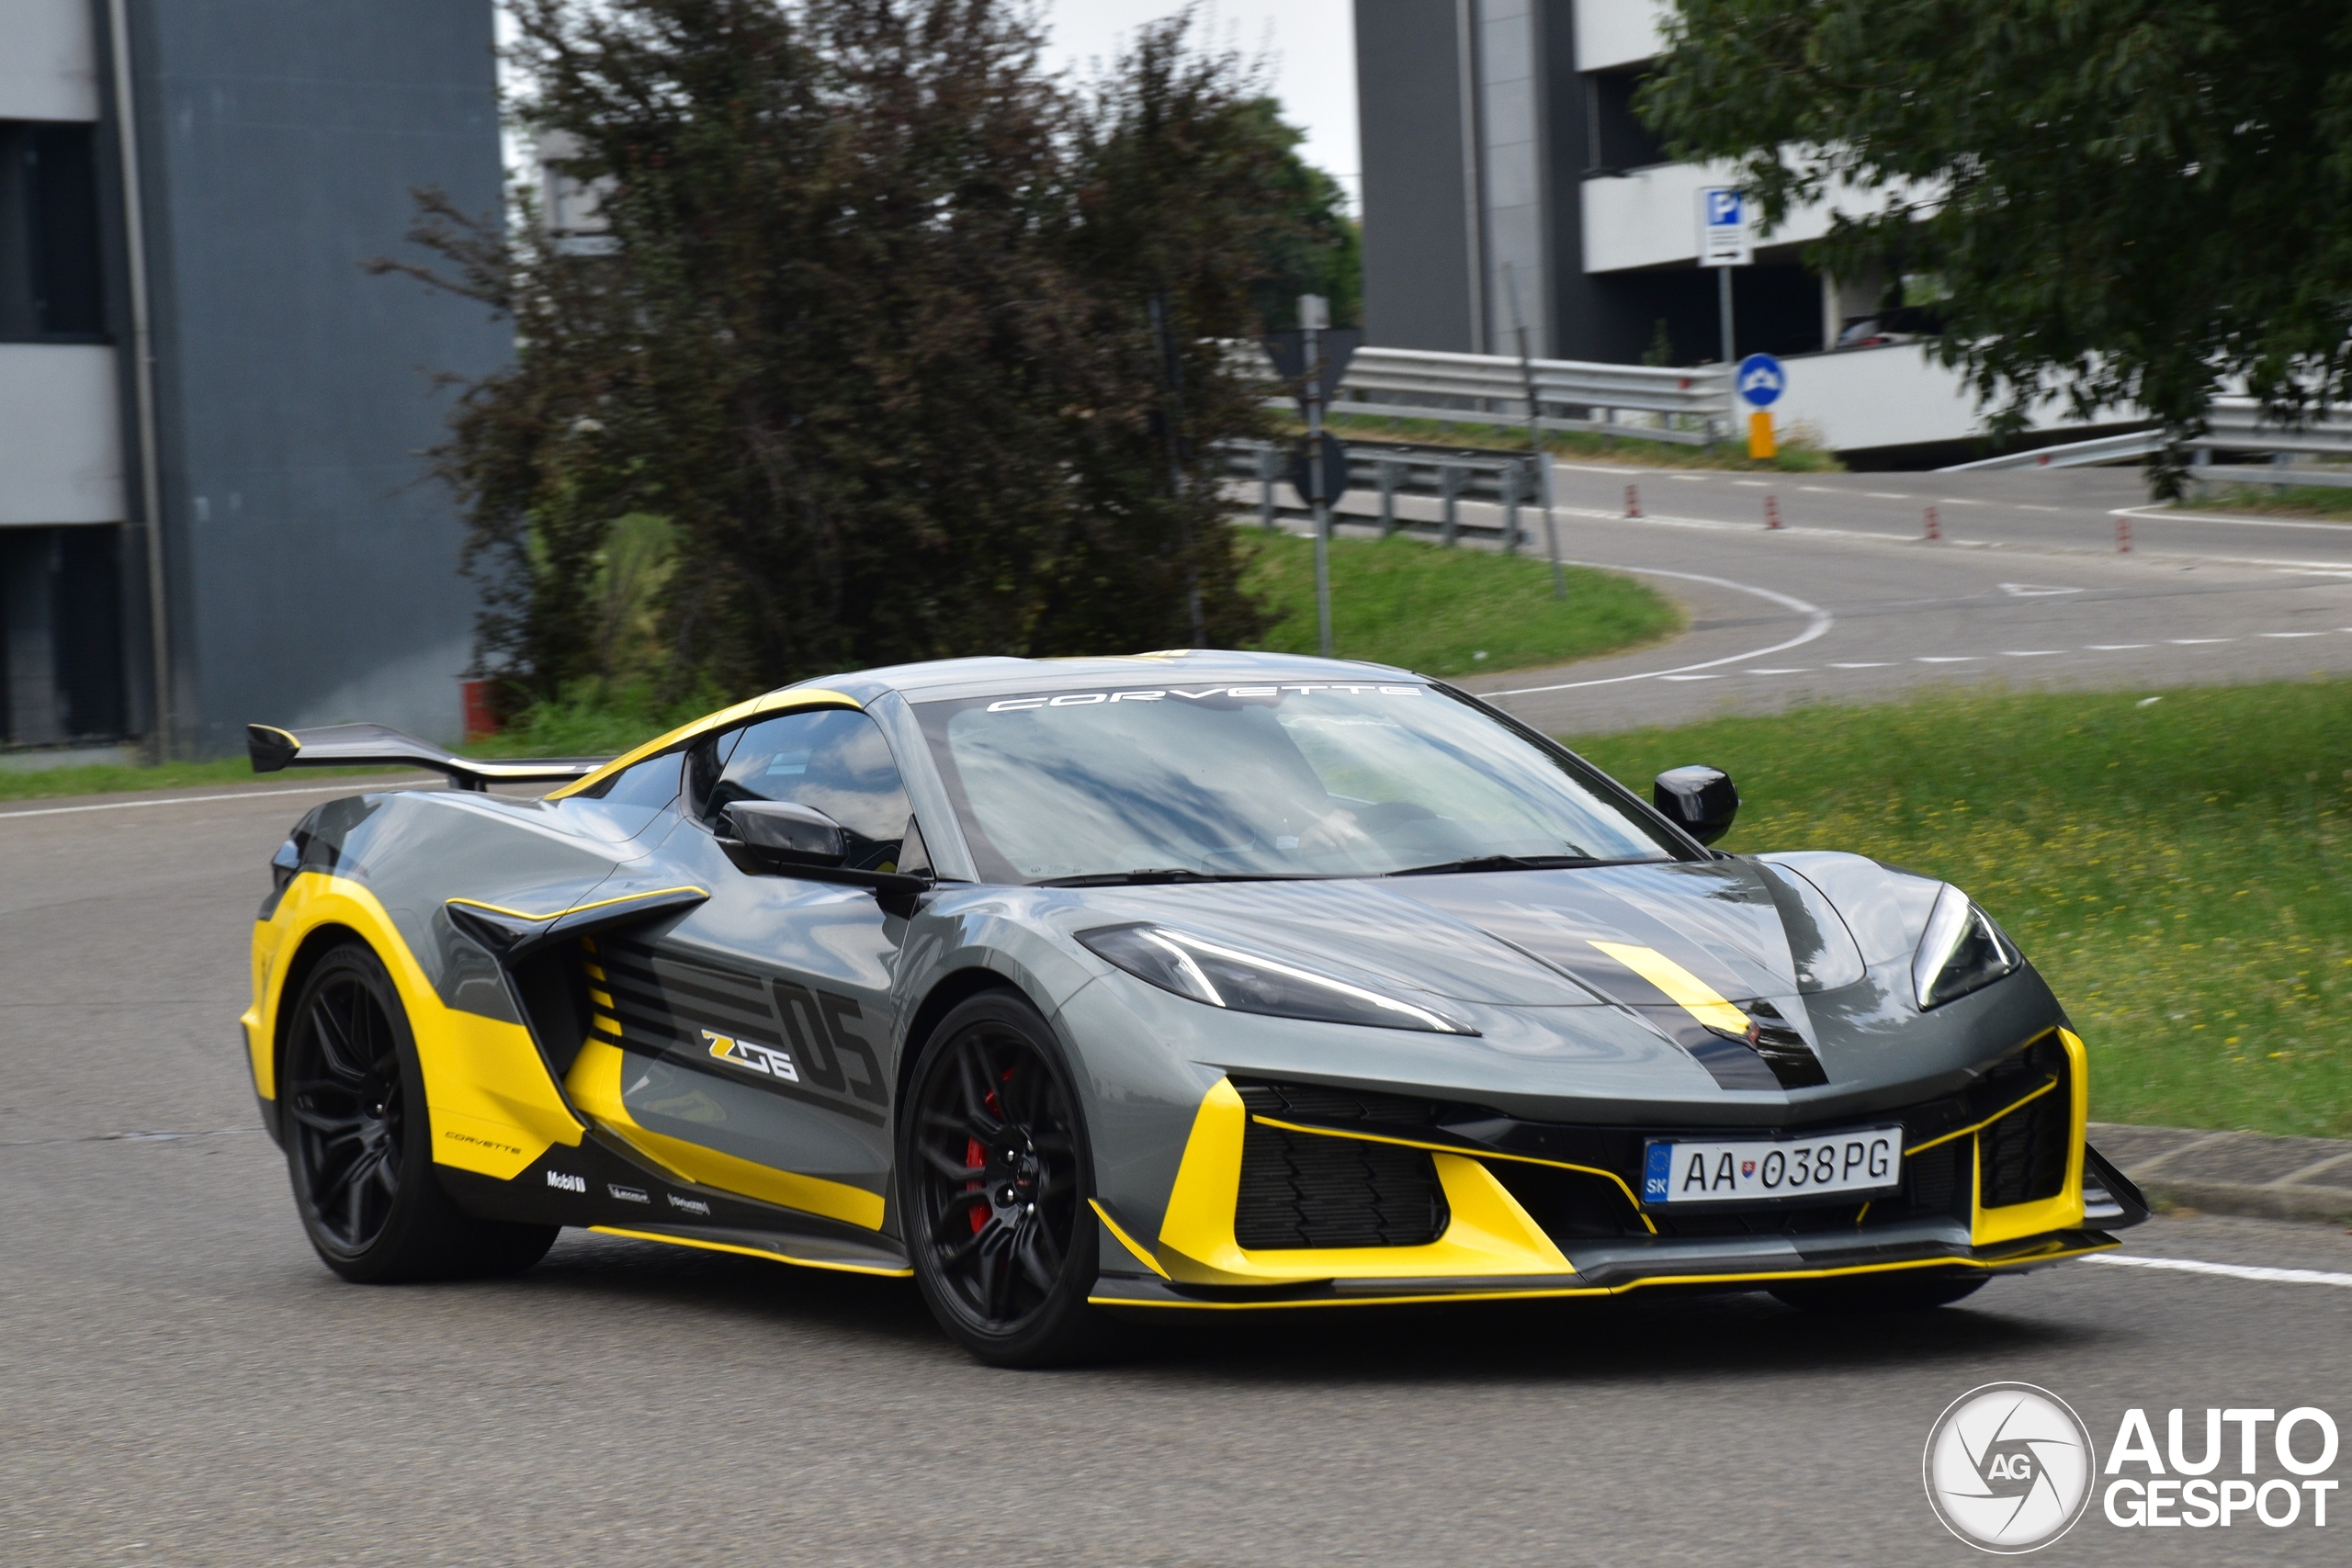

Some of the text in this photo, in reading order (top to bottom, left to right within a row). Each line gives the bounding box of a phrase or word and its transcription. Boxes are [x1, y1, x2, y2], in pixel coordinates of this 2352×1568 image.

[986, 685, 1423, 713] CORVETTE
[701, 1029, 799, 1083] Z06
[772, 976, 890, 1108] 05
[445, 1131, 522, 1156] CORVETTE
[1646, 1179, 1667, 1194] SK
[1683, 1152, 1736, 1191] AA
